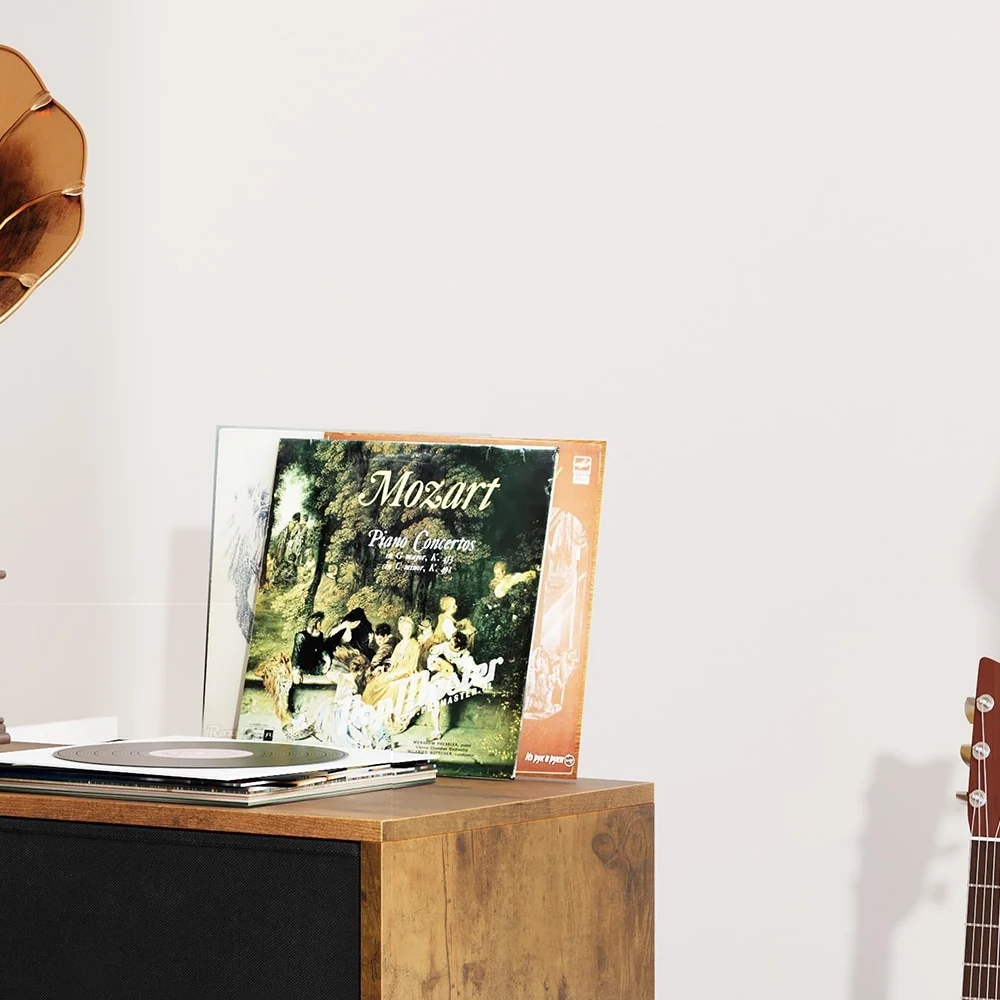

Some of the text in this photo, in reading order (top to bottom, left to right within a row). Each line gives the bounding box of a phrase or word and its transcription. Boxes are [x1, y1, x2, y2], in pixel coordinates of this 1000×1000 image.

[358, 469, 501, 511] Mozart
[368, 529, 477, 552] Piano Concertos
